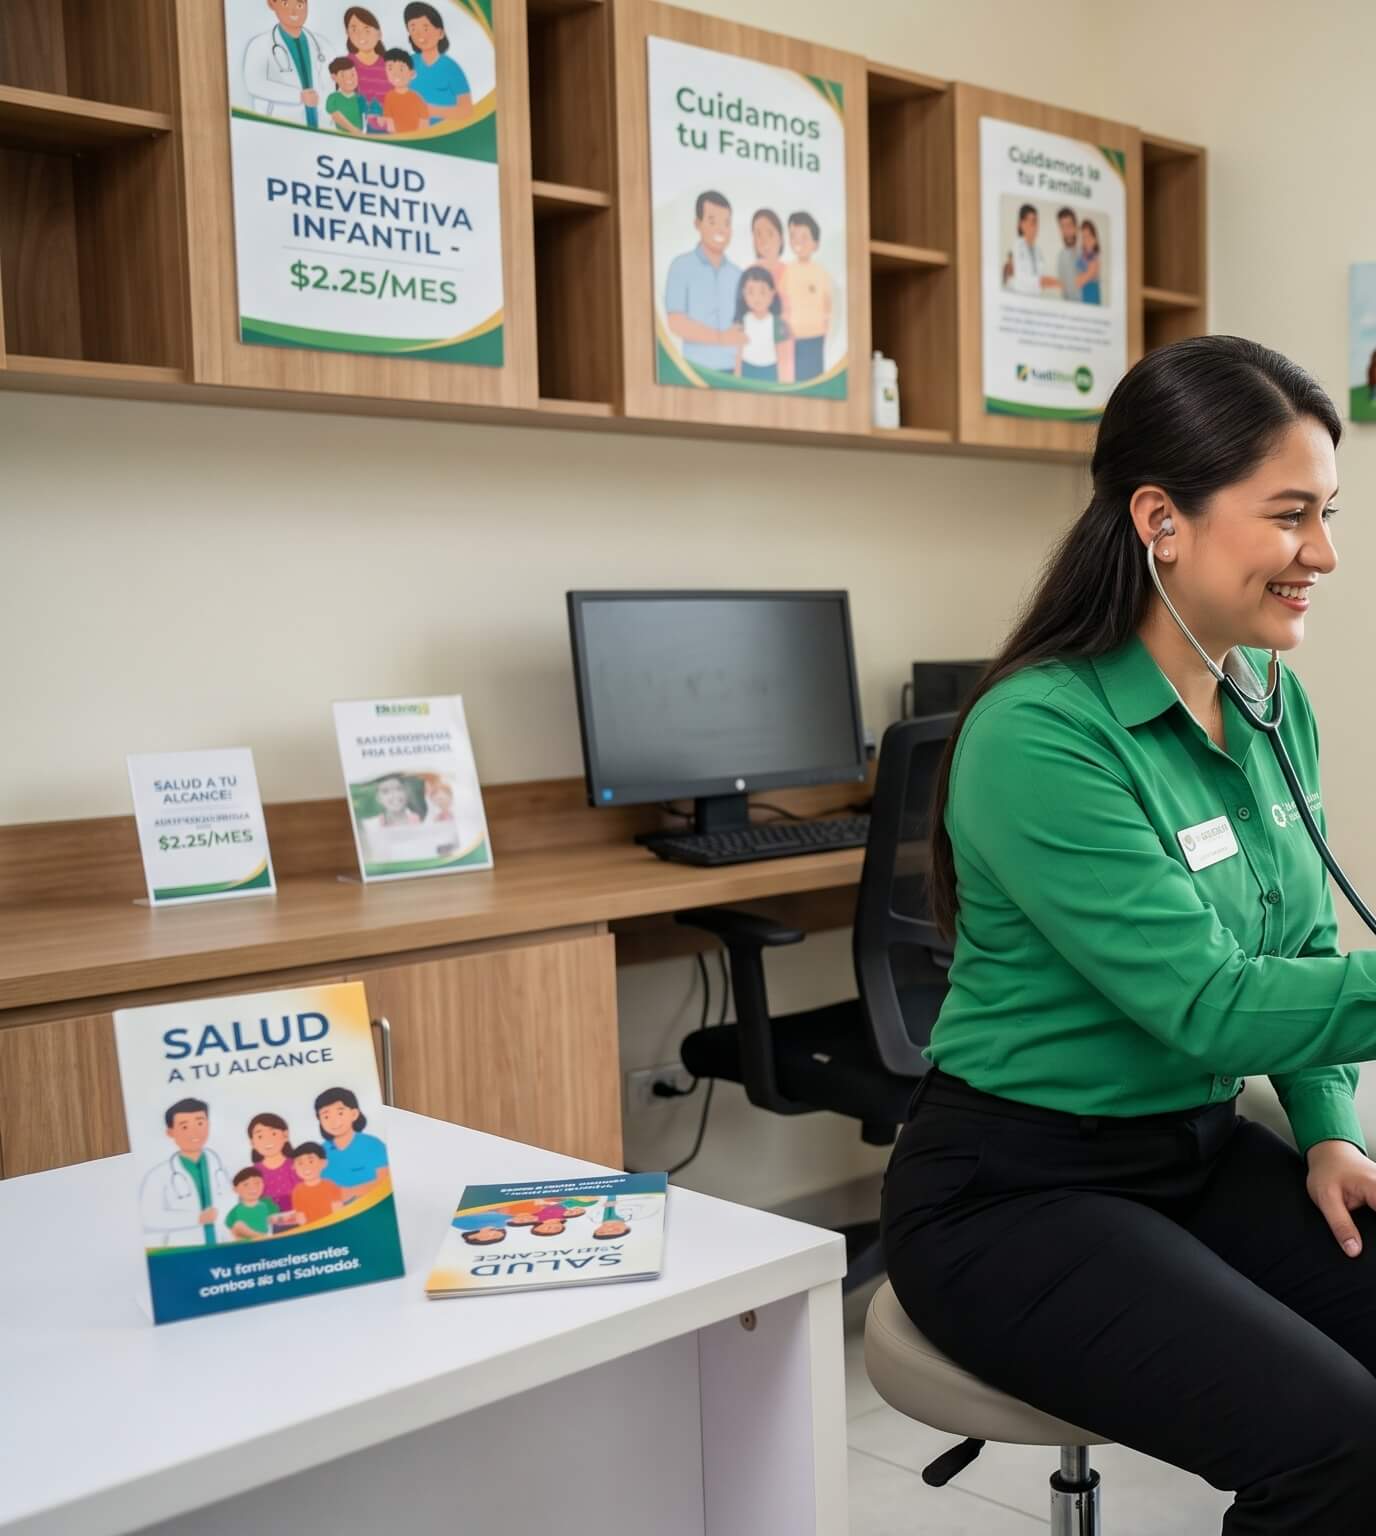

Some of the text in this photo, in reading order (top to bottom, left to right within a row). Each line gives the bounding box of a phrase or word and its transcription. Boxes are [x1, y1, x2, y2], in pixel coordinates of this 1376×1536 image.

[675, 87, 821, 140] Cuidamos
[676, 122, 821, 173] tu Familia
[316, 154, 426, 193] SALUD
[266, 177, 473, 232] PREVENTIVA
[292, 212, 441, 256] INFANTIL
[289, 259, 458, 305] $2.25/MES
[153, 775, 238, 793] SALUD A TU
[158, 829, 254, 854] $2.25/MES
[162, 1011, 330, 1061] SALUD
[168, 1047, 334, 1084] A TU ALCANCE
[470, 1252, 622, 1277] SALUD
